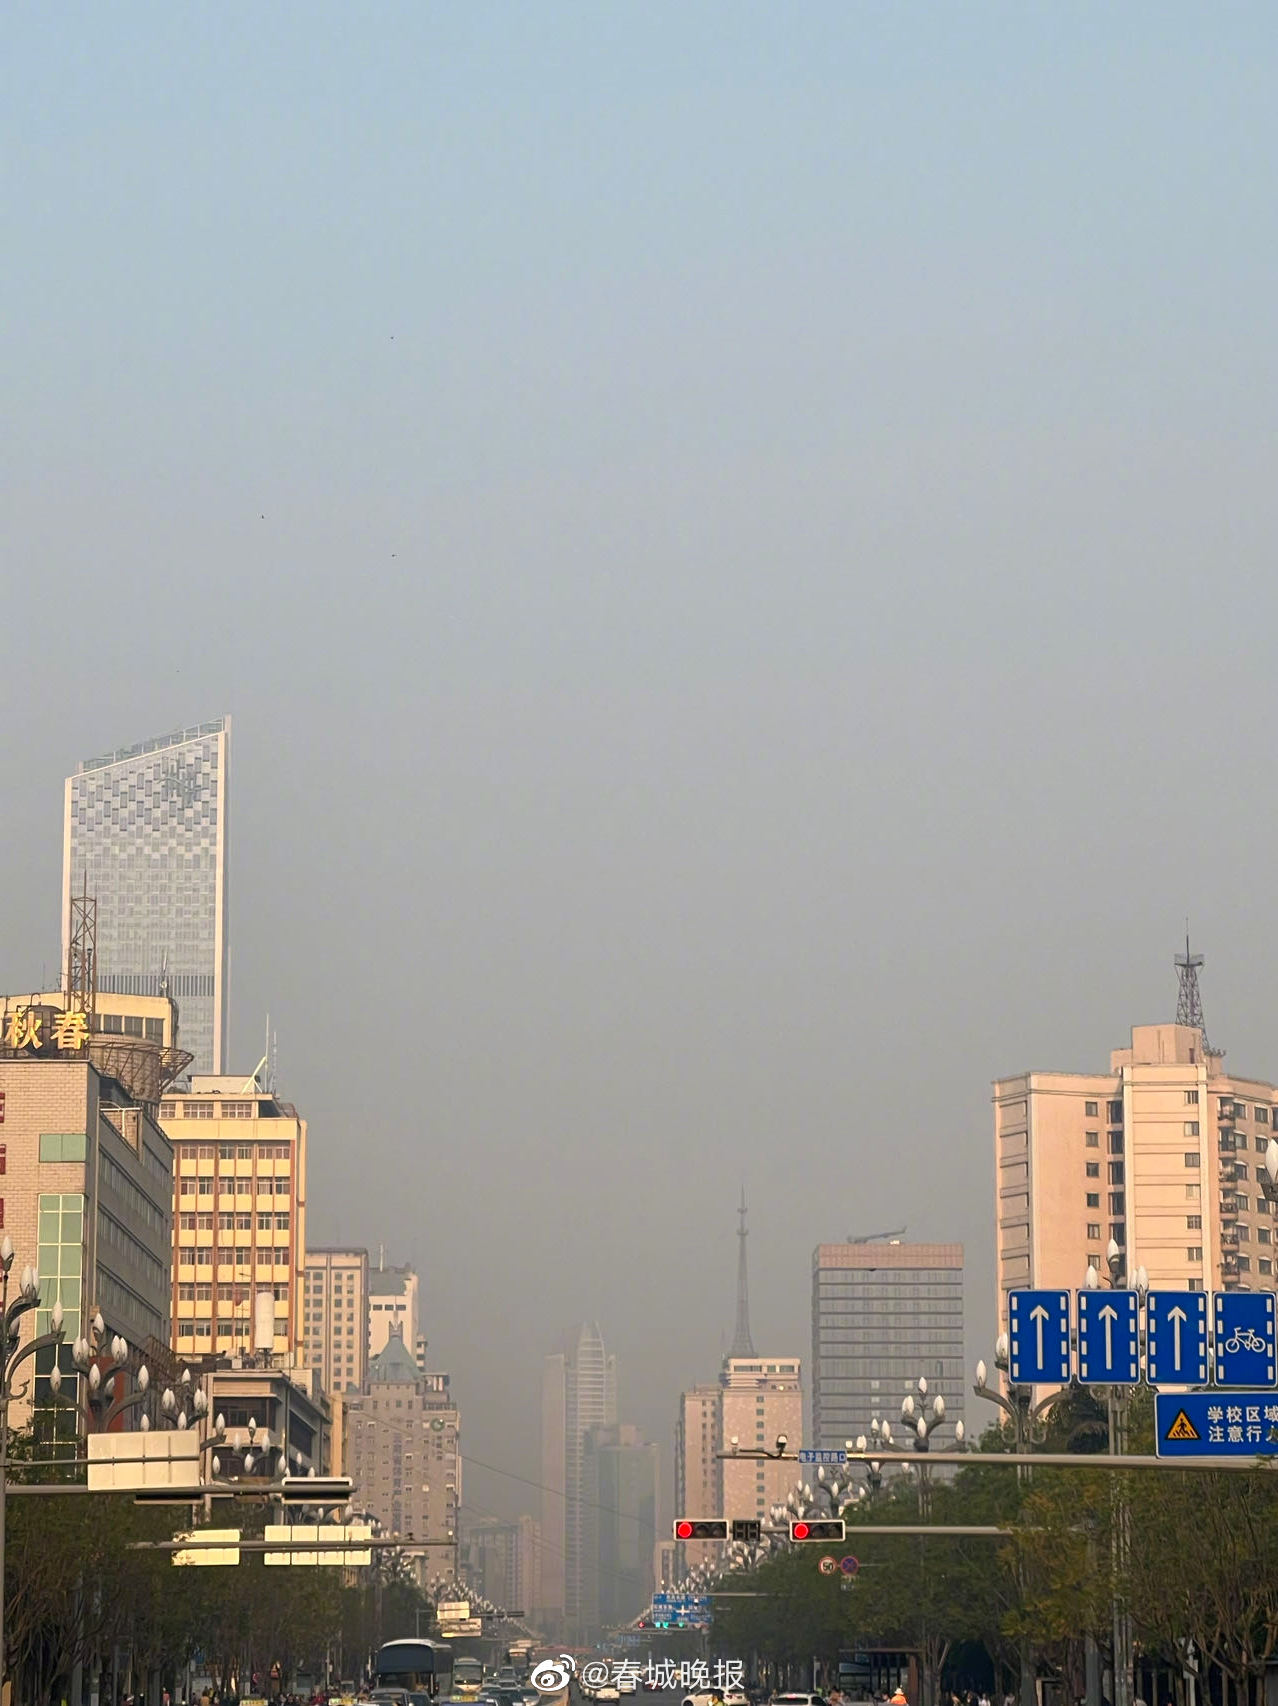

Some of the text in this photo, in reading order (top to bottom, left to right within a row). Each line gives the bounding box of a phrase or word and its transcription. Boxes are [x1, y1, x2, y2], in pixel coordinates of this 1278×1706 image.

[1207, 1405, 1278, 1424] 学校区域
[822, 1561, 834, 1571] 50
